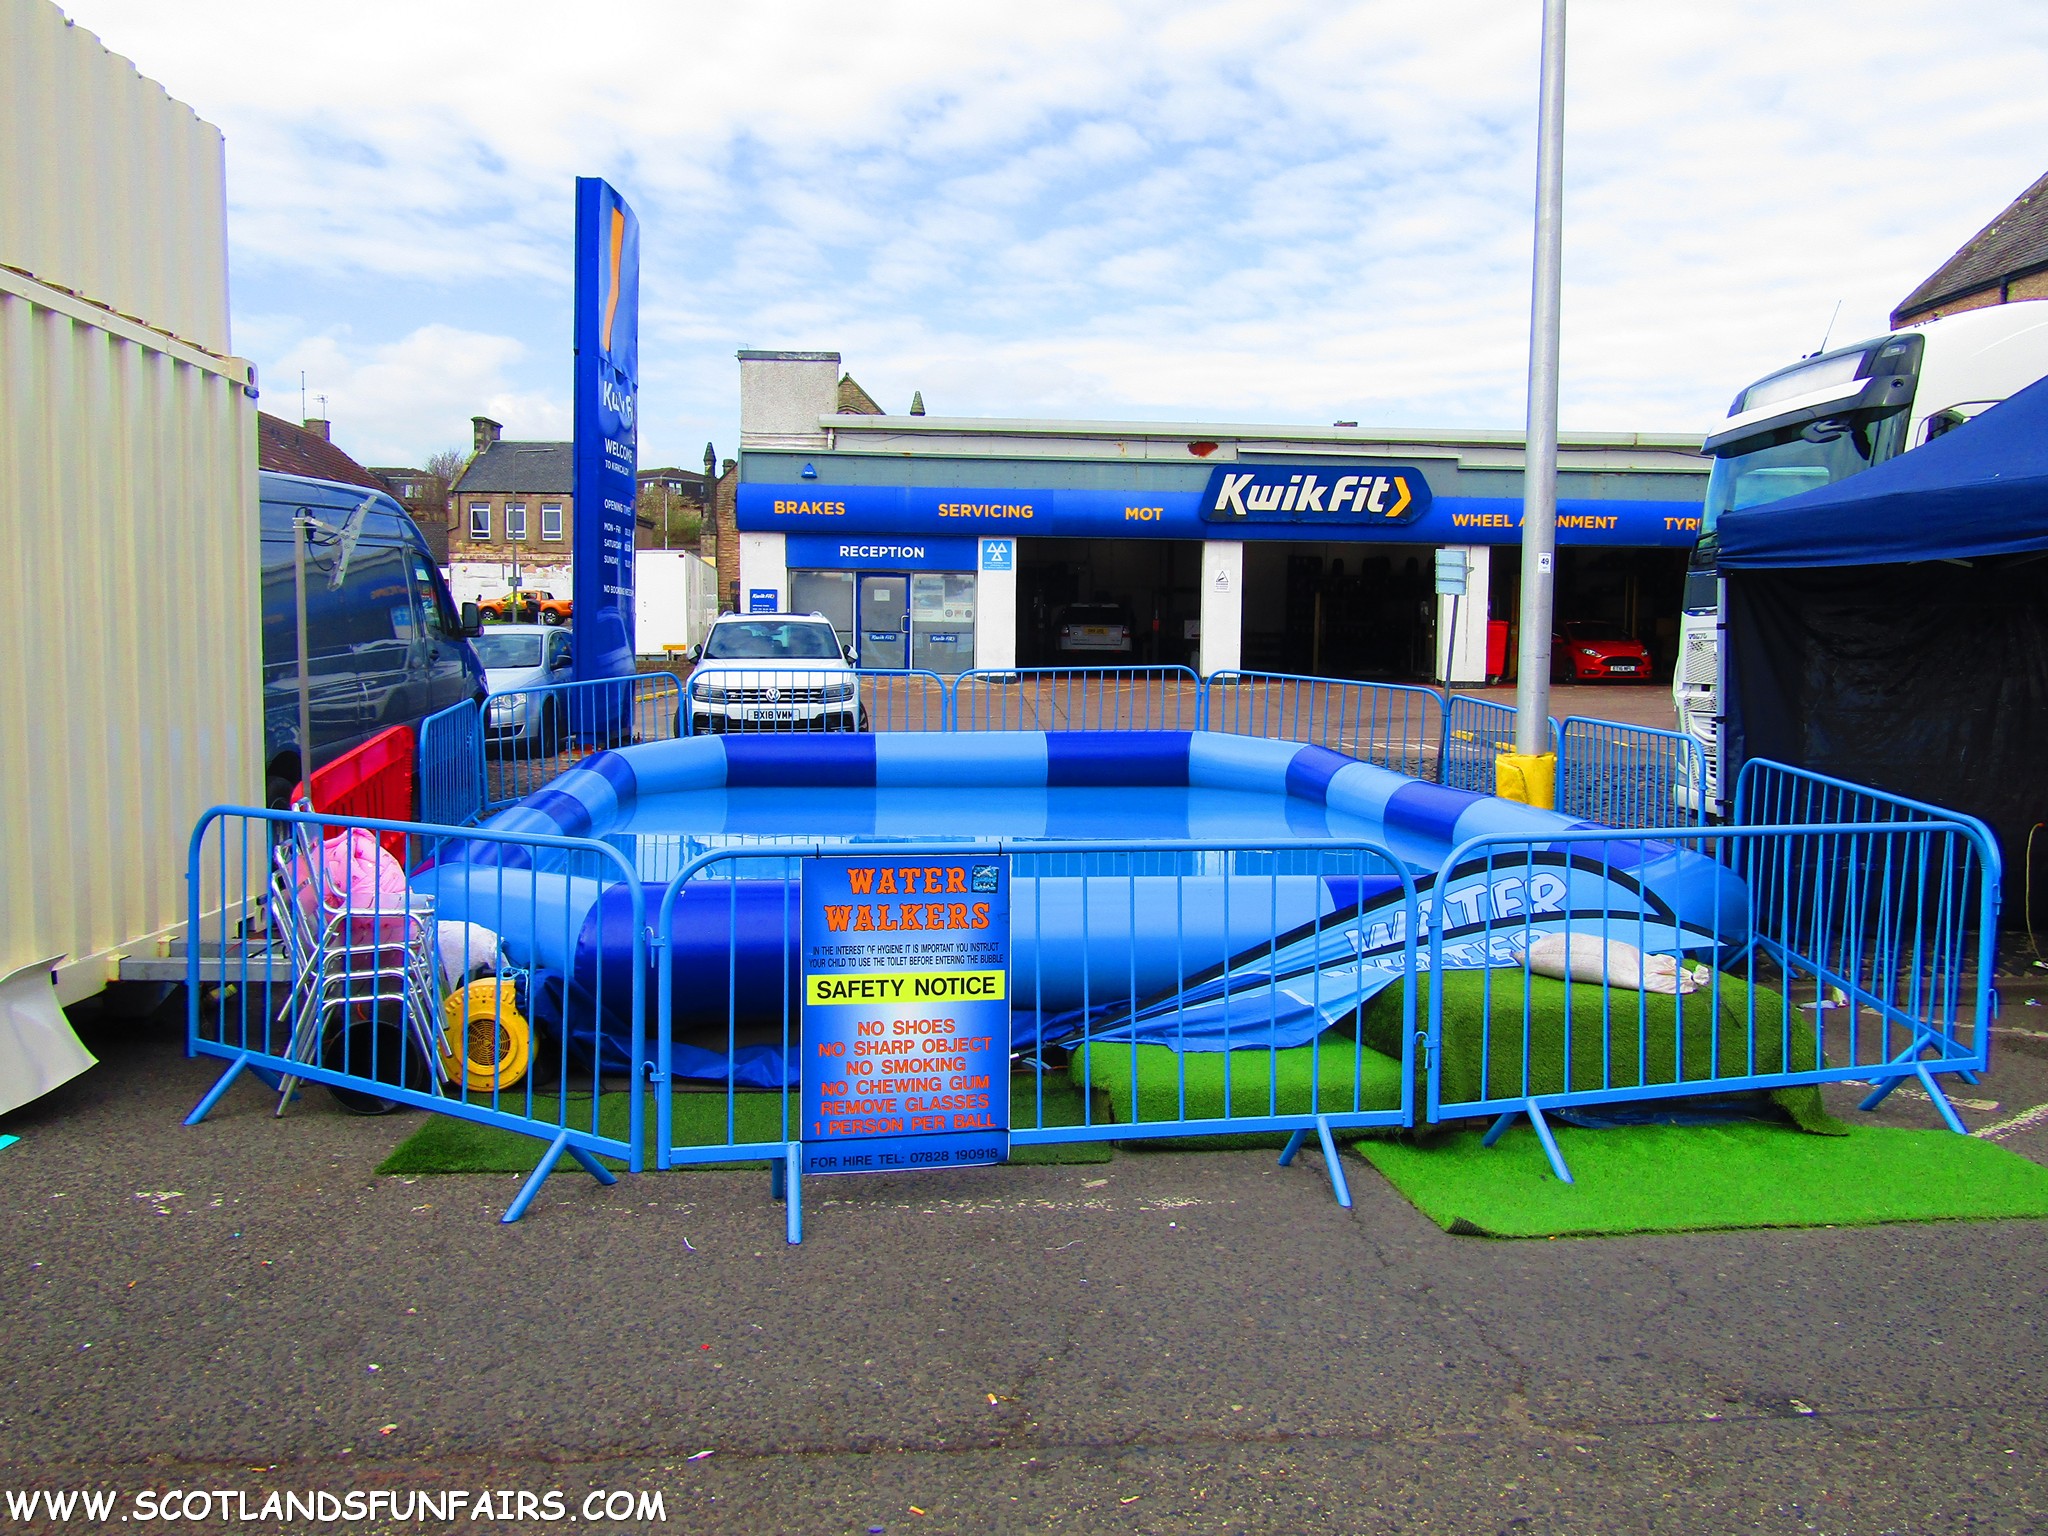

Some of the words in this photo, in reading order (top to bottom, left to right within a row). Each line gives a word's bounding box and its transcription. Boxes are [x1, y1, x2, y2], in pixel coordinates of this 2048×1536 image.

[605, 438, 633, 464] WELCOME
[605, 459, 612, 469] TO
[604, 499, 623, 513] OPENING
[773, 500, 846, 516] BRAKES
[938, 504, 1034, 519] SERVICING
[1125, 507, 1164, 522] MOT
[1452, 514, 1513, 528] WHEEL
[604, 539, 622, 549] SATURDAY
[840, 545, 925, 558] RECEPTION
[604, 555, 620, 565] SUNDAY
[1540, 558, 1549, 566] 49
[754, 710, 774, 719] BX18
[847, 867, 968, 894] WATER
[824, 902, 990, 932] WALKERS
[813, 946, 819, 955] IN
[822, 946, 833, 955] THE
[836, 945, 864, 955] INTEREST
[867, 945, 875, 954] OF
[878, 944, 903, 954] HYGIENE
[905, 944, 910, 953] IT
[913, 944, 918, 953] IS
[921, 943, 954, 953] IMPORTANT
[956, 943, 968, 952] YOU
[970, 942, 999, 952] INSTRUCT
[809, 957, 825, 967] YOUR
[828, 957, 846, 967] CHILD
[849, 957, 856, 966] TO
[859, 957, 870, 966] USE
[873, 957, 884, 966] THE
[887, 956, 907, 966] TOILET
[910, 956, 934, 965] BEFORE
[936, 955, 964, 964] ENTERING
[967, 955, 977, 964] THE
[980, 954, 1003, 963] BUBBLE
[817, 978, 904, 999] SAFETY
[915, 976, 996, 996] NOTICE
[858, 1021, 884, 1036] NO
[893, 1019, 955, 1035] SHOES
[818, 1042, 845, 1057] NO
[854, 1040, 915, 1056] SHARP
[922, 1037, 992, 1053] OBJECT
[846, 1061, 873, 1075] NO
[881, 1056, 966, 1074] SMOKING
[821, 1081, 848, 1096] NO
[856, 1077, 941, 1095] CHEWING
[949, 1075, 990, 1090] GUM
[821, 1098, 897, 1116] REMOVE
[905, 1094, 989, 1112] GLASSES
[814, 1121, 821, 1135] 1
[829, 1117, 903, 1135] PERSON
[911, 1115, 945, 1131] PER
[954, 1114, 996, 1128] BALL
[810, 1156, 837, 1168] FOR
[843, 1155, 872, 1166] HIRE
[880, 1153, 904, 1165] TEL:
[910, 1151, 949, 1163] 07828
[956, 1148, 998, 1160] 190918
